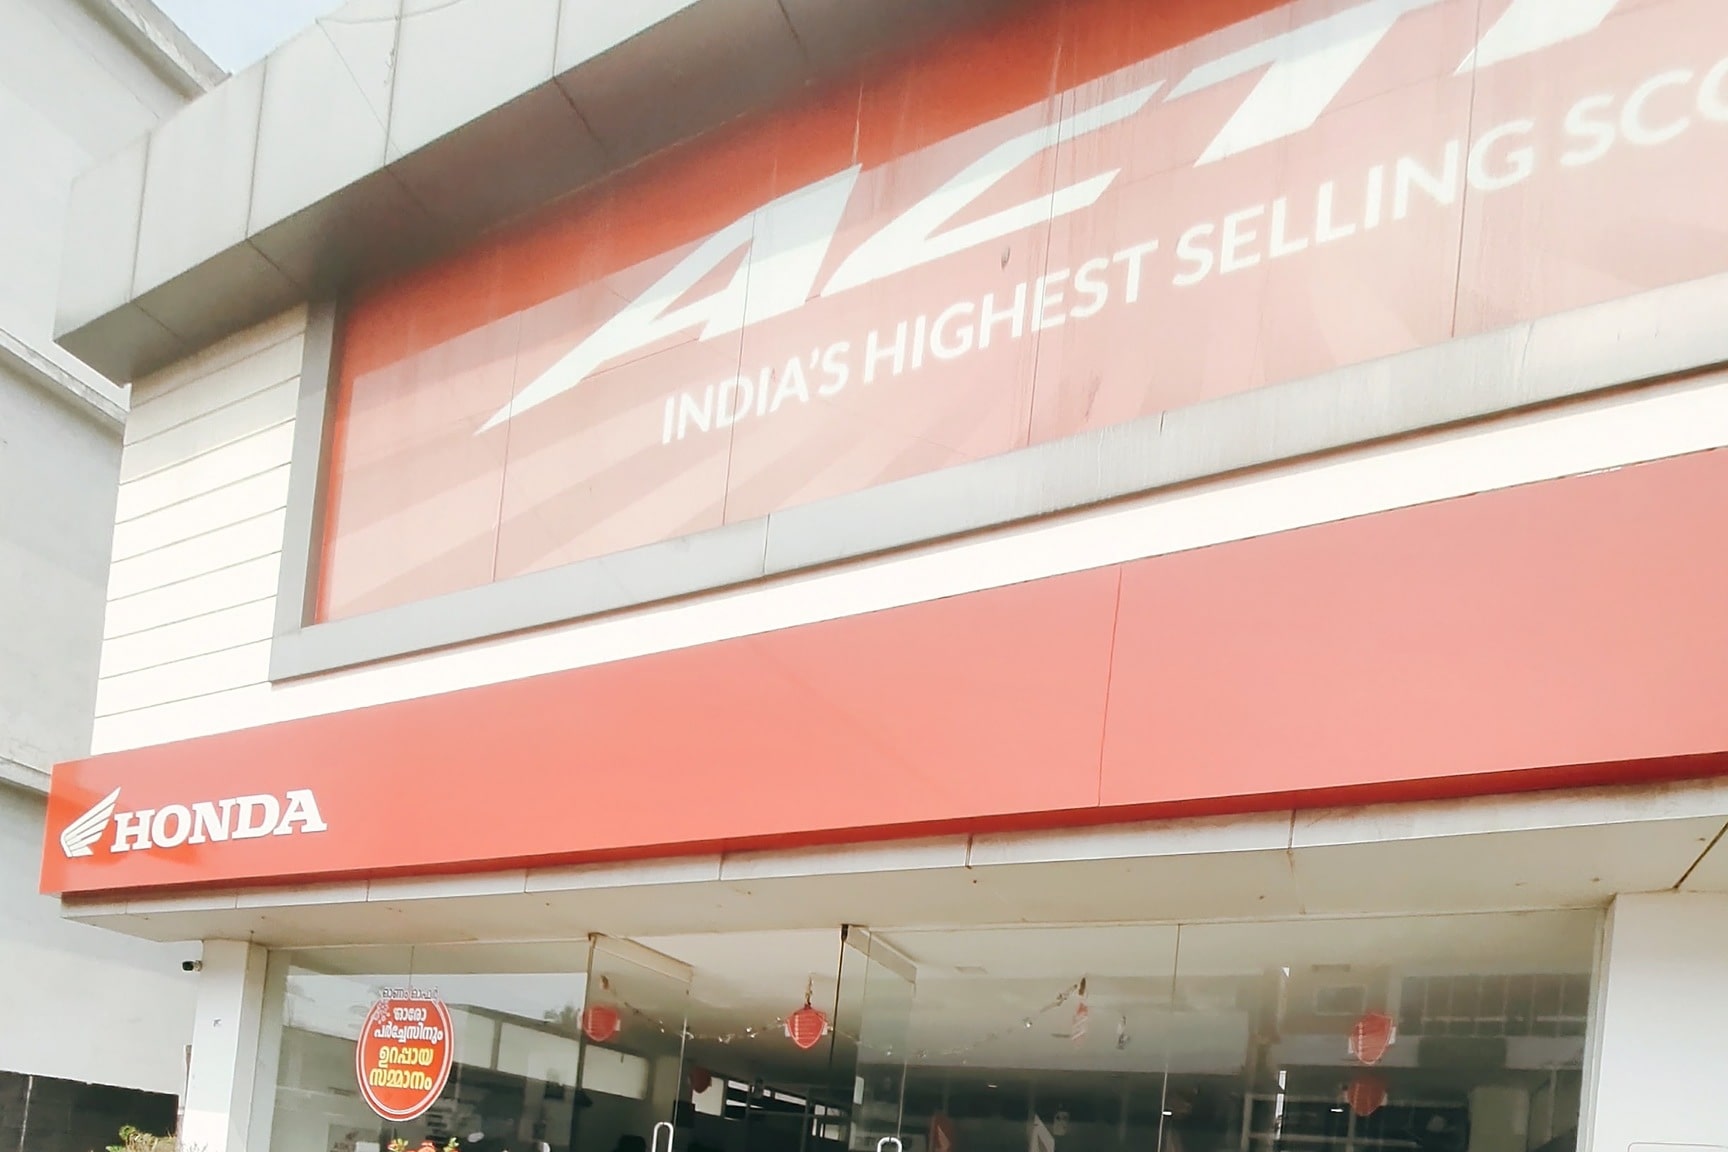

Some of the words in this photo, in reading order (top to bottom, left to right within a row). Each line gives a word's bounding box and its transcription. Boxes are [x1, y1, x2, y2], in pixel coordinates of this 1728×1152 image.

[661, 340, 850, 444] INDIA'S
[863, 237, 1159, 385] HIGHEST
[1171, 117, 1537, 288] SELLING
[110, 789, 328, 854] HONDA
